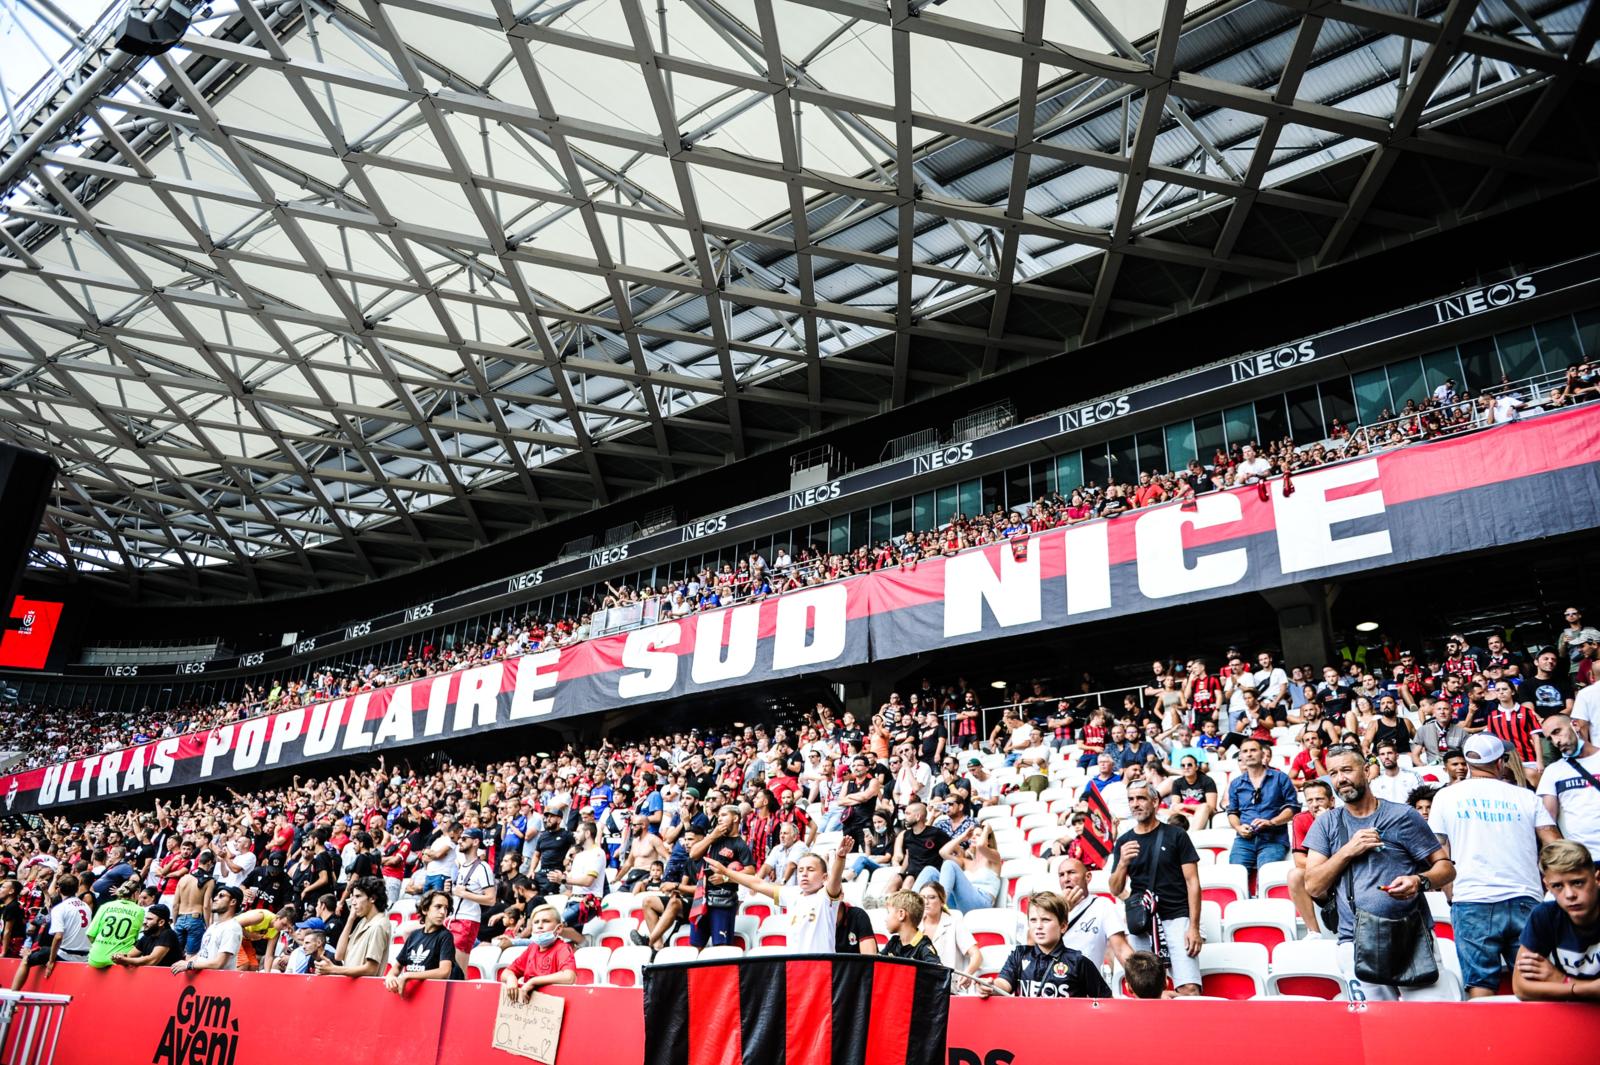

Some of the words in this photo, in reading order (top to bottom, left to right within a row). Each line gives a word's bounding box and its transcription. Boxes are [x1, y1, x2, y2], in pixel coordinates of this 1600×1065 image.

[1434, 275, 1537, 324] INEOS
[1230, 341, 1316, 383] INEOS
[1058, 395, 1130, 433] INEOS
[913, 442, 974, 476] INEOS
[788, 481, 841, 511] INEOS
[681, 515, 728, 542] INEOS
[588, 544, 629, 569] INEOS
[507, 570, 543, 593] INEOS
[403, 602, 435, 623] INEOS
[37, 737, 181, 806] ULTRAS
[200, 647, 561, 778] POPULAIRE
[618, 583, 848, 699] SUD
[943, 458, 1393, 639] NICE
[344, 621, 372, 641] INEOS
[291, 637, 317, 657] INEOS
[105, 666, 139, 677] INEOS
[176, 662, 206, 675] INEOS
[238, 652, 265, 668] INEOS
[79, 909, 89, 928] 3
[101, 915, 132, 940] 30
[1016, 979, 1070, 998] NEOS
[177, 985, 231, 1034] Gym
